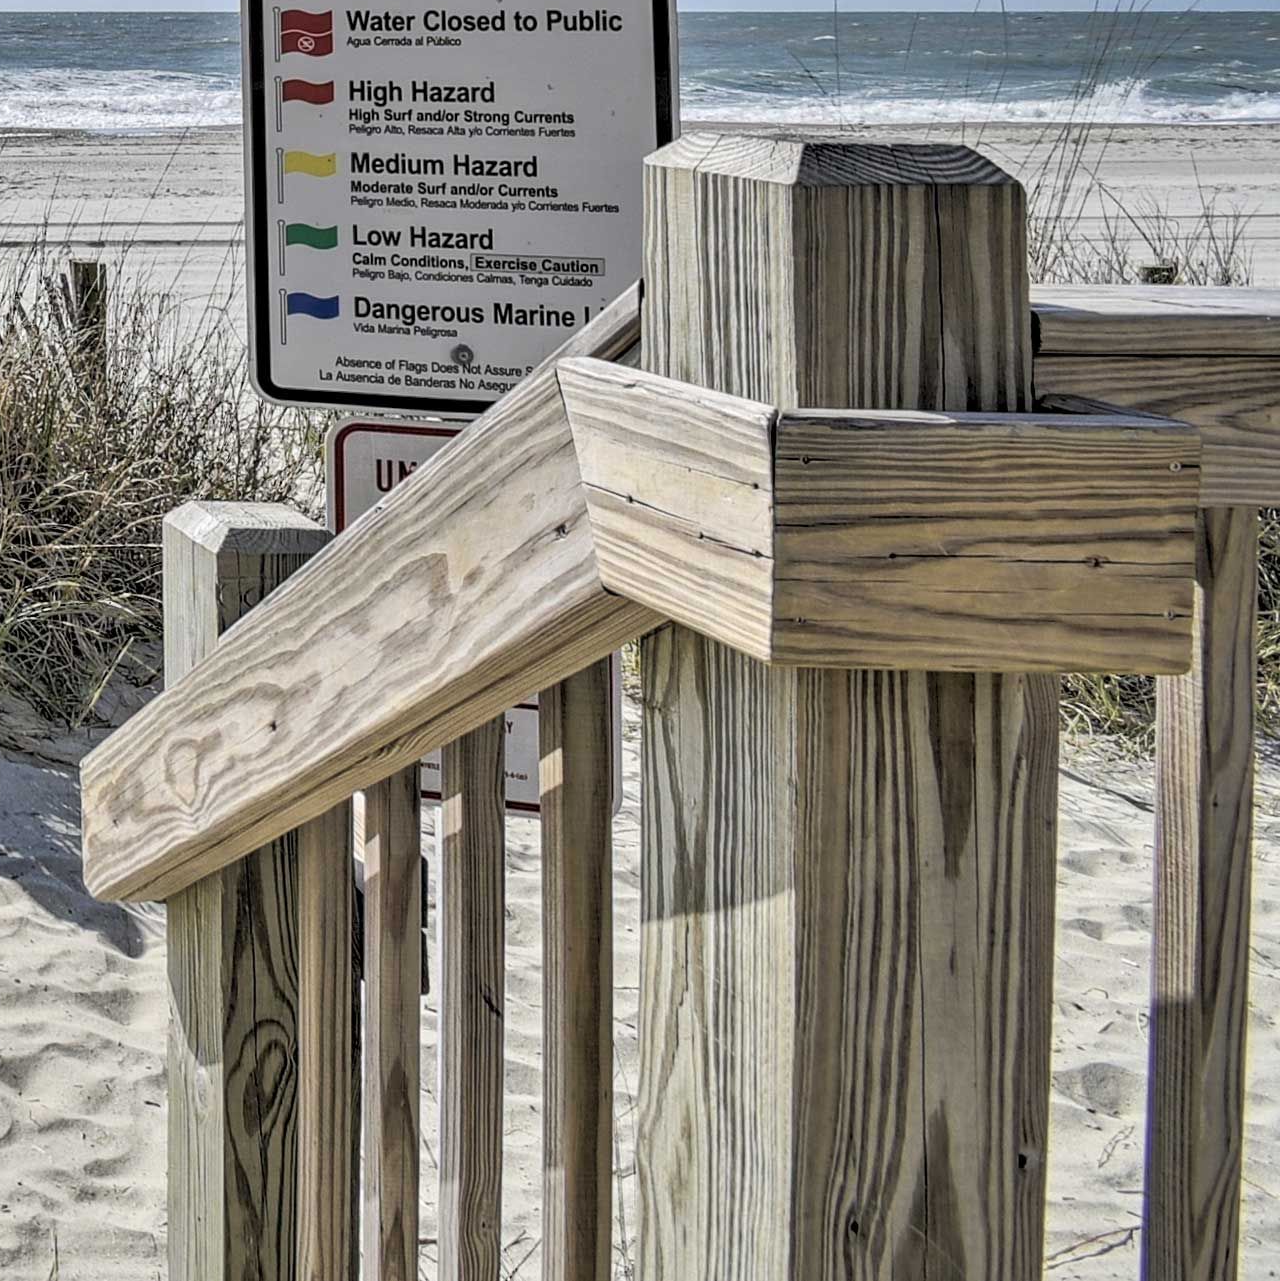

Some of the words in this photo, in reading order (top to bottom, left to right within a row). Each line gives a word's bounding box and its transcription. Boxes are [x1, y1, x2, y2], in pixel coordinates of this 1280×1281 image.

[346, 10, 416, 31] Water
[423, 10, 505, 31] Closed
[513, 11, 538, 31] to
[546, 10, 623, 31] Public
[346, 37, 371, 48] Agua
[373, 36, 412, 47] Cerrada
[415, 36, 424, 46] al
[349, 80, 403, 107] High
[411, 81, 495, 103] Hazard
[349, 108, 380, 124] High
[384, 108, 413, 122] Surf
[416, 109, 460, 122] and/or
[464, 110, 510, 126] Strong
[514, 111, 575, 124] Currents
[349, 124, 381, 136] Peligro
[384, 125, 405, 135] Alto,
[408, 124, 444, 135] Resaca
[447, 126, 466, 136] Alta
[485, 126, 536, 137] Corrientes
[538, 127, 576, 137] Fuertes
[351, 152, 444, 175] Medium
[453, 154, 538, 177] Hazard
[350, 180, 414, 194] Moderate
[417, 182, 447, 195] Surf
[450, 183, 494, 196] and/or
[498, 184, 559, 198] Currents
[350, 196, 384, 208] Peligro
[421, 198, 457, 208] Resaca
[460, 198, 509, 210] Moderada
[528, 200, 579, 212] Corrientes
[582, 202, 620, 213] Fuertes
[352, 224, 401, 246] Low
[410, 226, 494, 250] Hazard
[352, 252, 387, 266] Calm
[390, 253, 469, 271] Conditions,
[474, 256, 537, 271] Exercise
[541, 259, 599, 273] Caution
[352, 268, 385, 280] Peligro
[414, 271, 474, 283] Condiciones
[476, 273, 516, 285] Calmas,
[520, 274, 549, 287] Tenga
[551, 276, 593, 287] Cuidado
[354, 296, 485, 326] Dangerous
[493, 302, 575, 327] Marine
[353, 322, 375, 333] Vida
[377, 324, 411, 335] Marina
[413, 325, 458, 339] Peligrosa
[335, 356, 382, 370] Absence
[385, 358, 396, 369] of
[398, 359, 428, 373] Flags
[431, 361, 459, 375] Does
[462, 363, 482, 375] Not
[484, 365, 523, 377] Assure
[319, 369, 333, 380] La
[335, 370, 385, 384] Ausencia
[388, 374, 402, 385] de
[404, 375, 456, 388] Banderas
[459, 377, 475, 390] No
